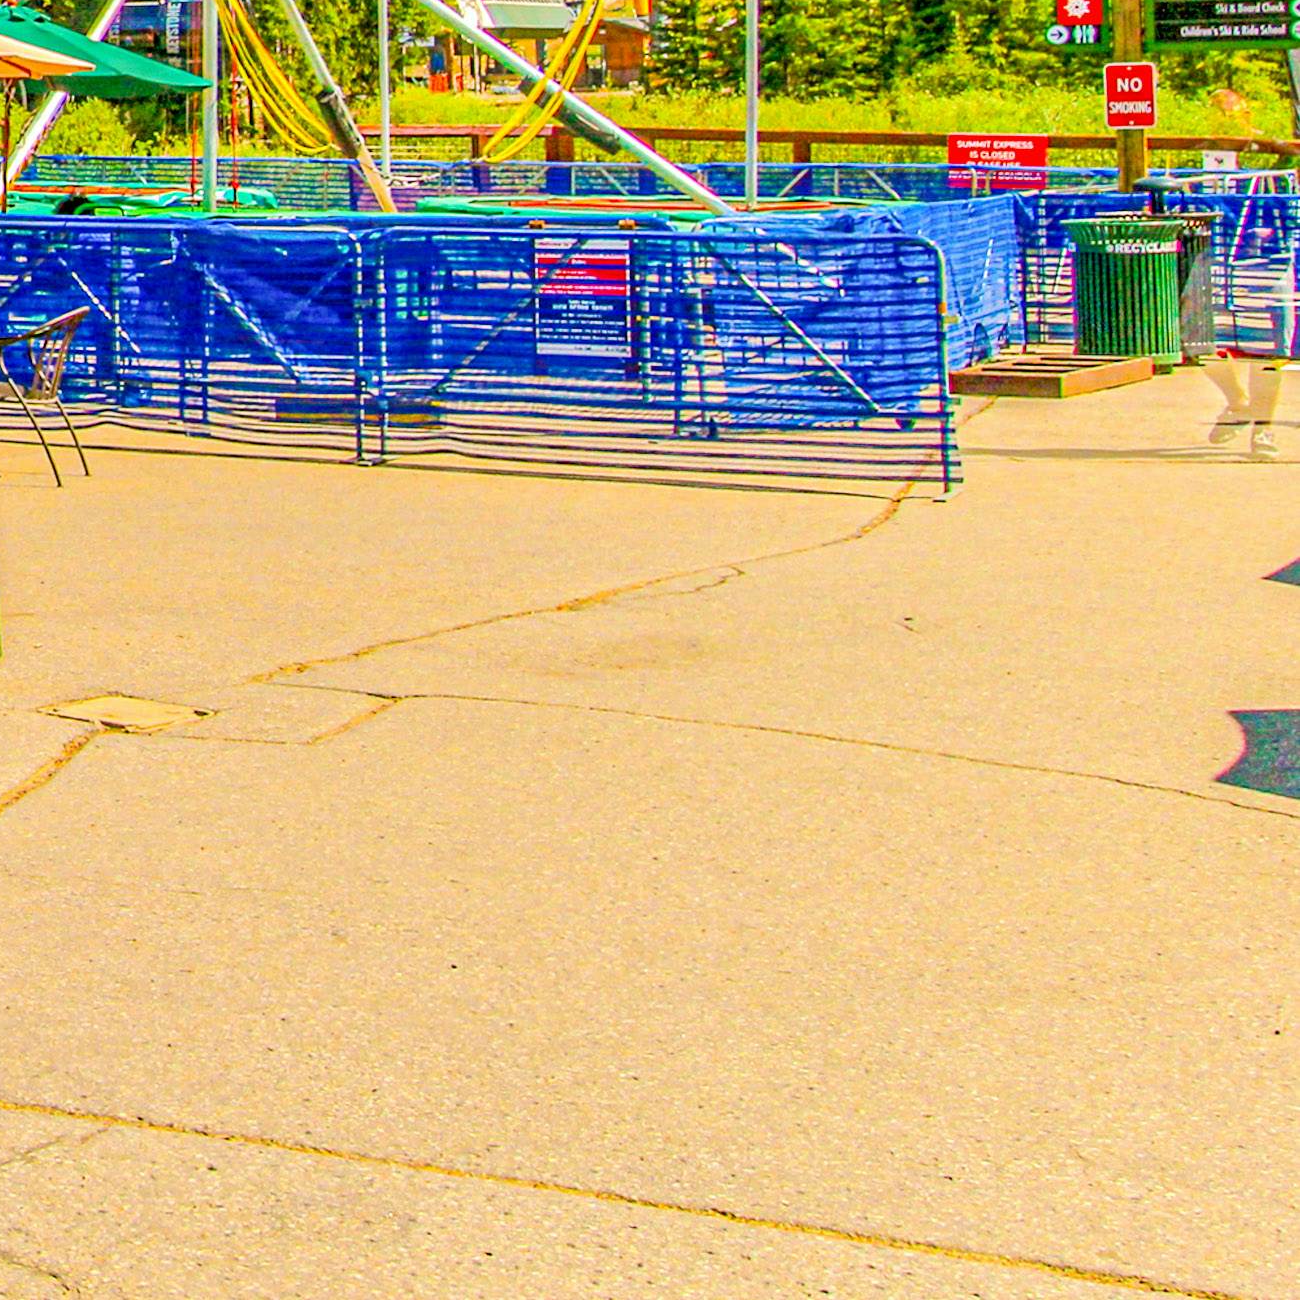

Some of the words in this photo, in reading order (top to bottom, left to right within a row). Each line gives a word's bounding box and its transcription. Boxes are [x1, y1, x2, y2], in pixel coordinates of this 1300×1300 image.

[1261, 2, 1286, 12] Check
[1260, 24, 1286, 35] School
[1116, 77, 1143, 93] NO
[1108, 101, 1152, 114] SMOKING
[957, 140, 991, 148] SUMMIT
[993, 141, 1034, 149] EXPRESS
[980, 151, 1016, 160] CLOSED
